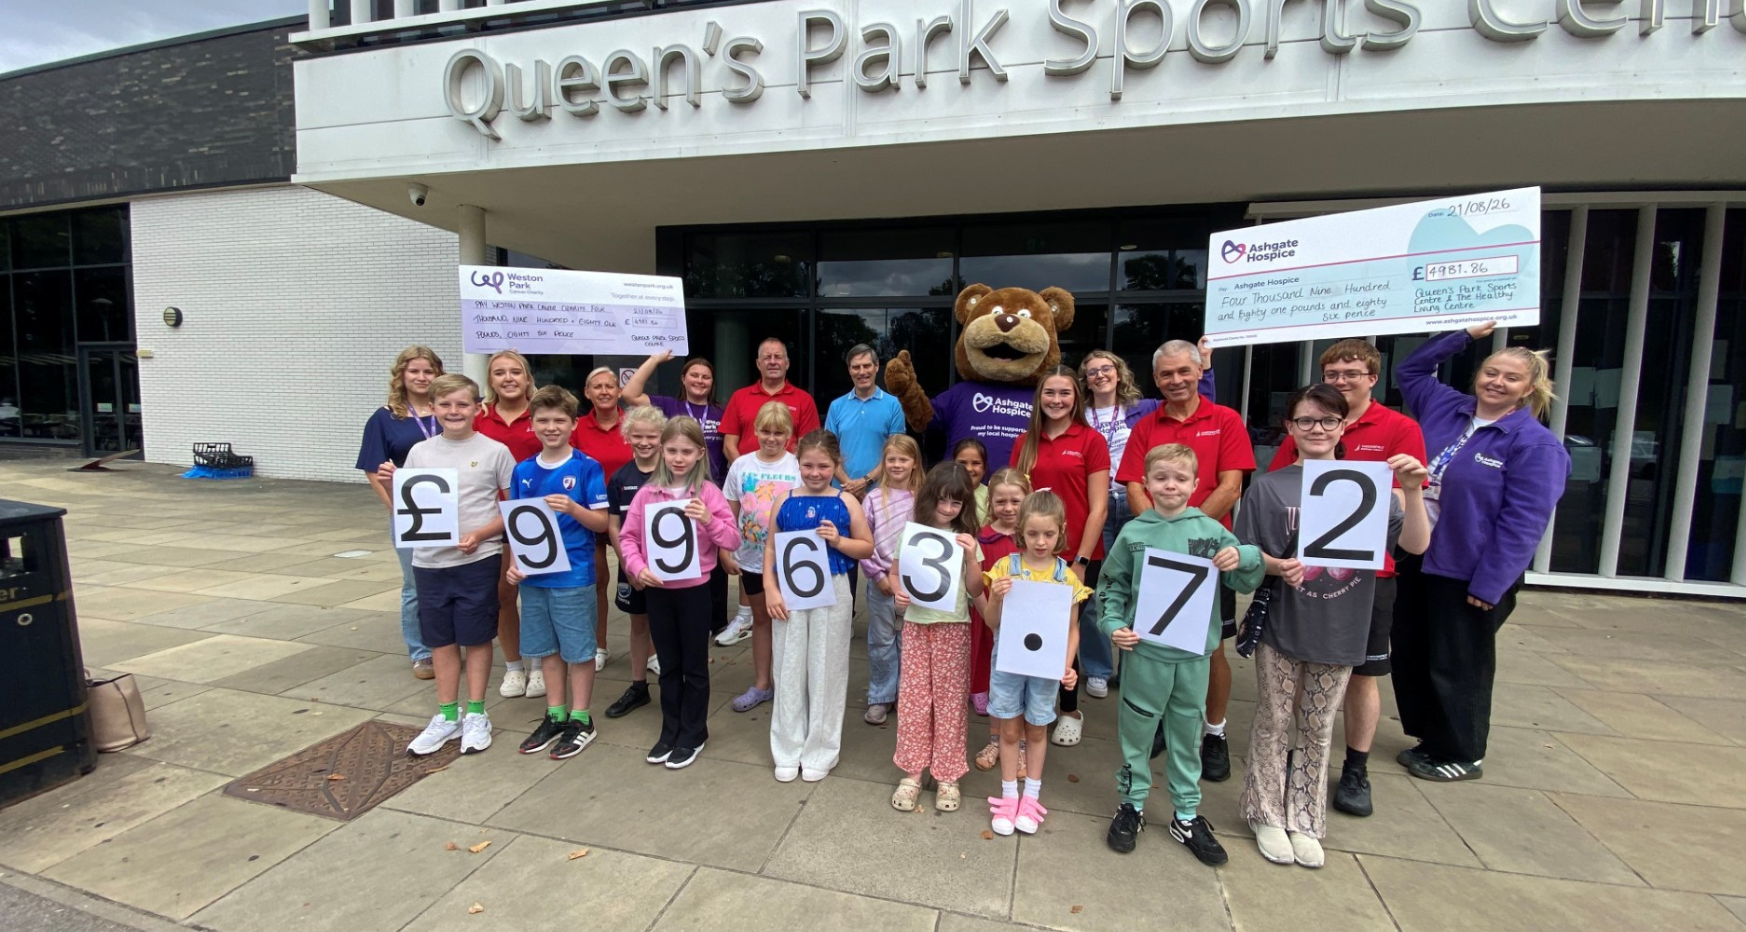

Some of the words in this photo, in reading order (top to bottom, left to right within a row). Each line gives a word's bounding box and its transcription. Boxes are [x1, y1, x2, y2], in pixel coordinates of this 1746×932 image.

[443, 20, 765, 141] Queen's
[797, 0, 1010, 99] Park
[1044, 0, 1423, 101] Sports
[1447, 198, 1510, 217] 21/08/26
[1250, 239, 1299, 253] Ashgate
[1246, 249, 1296, 263] Hospice
[507, 272, 544, 282] Weston
[1412, 266, 1425, 281] £
[1429, 262, 1488, 278] 4981.86
[509, 281, 531, 289] Park
[1234, 281, 1266, 290] Ashgate
[1268, 277, 1300, 286] Hospice
[1222, 296, 1248, 308] Four
[1252, 287, 1304, 304] Thousand
[1310, 286, 1332, 296] Nine
[1345, 280, 1391, 294] Hundred
[1414, 296, 1442, 306] Centre
[1456, 293, 1472, 301] The
[1476, 291, 1513, 301] Healthy
[1415, 286, 1455, 298] Queen's
[1460, 285, 1482, 293] Park
[1218, 310, 1235, 321] and
[1271, 306, 1287, 315] one
[1290, 302, 1326, 318] pounds
[1330, 299, 1351, 310] and
[1356, 297, 1388, 311] eighty
[1345, 309, 1376, 320] pence
[1414, 304, 1440, 314] Living
[1444, 302, 1475, 310] Centre
[1425, 314, 1518, 325] www.ashgatehospice.org.uk
[992, 405, 1032, 419] Hospice
[995, 398, 1034, 411] Ashgate
[397, 474, 451, 541] £
[1304, 469, 1377, 562] 2
[508, 505, 558, 569] 9
[652, 507, 694, 574] 9
[782, 537, 825, 598] 6
[902, 532, 954, 602] 3
[1323, 586, 1350, 600] CHERRY
[1350, 576, 1362, 588] PIE
[1148, 556, 1209, 636] 7
